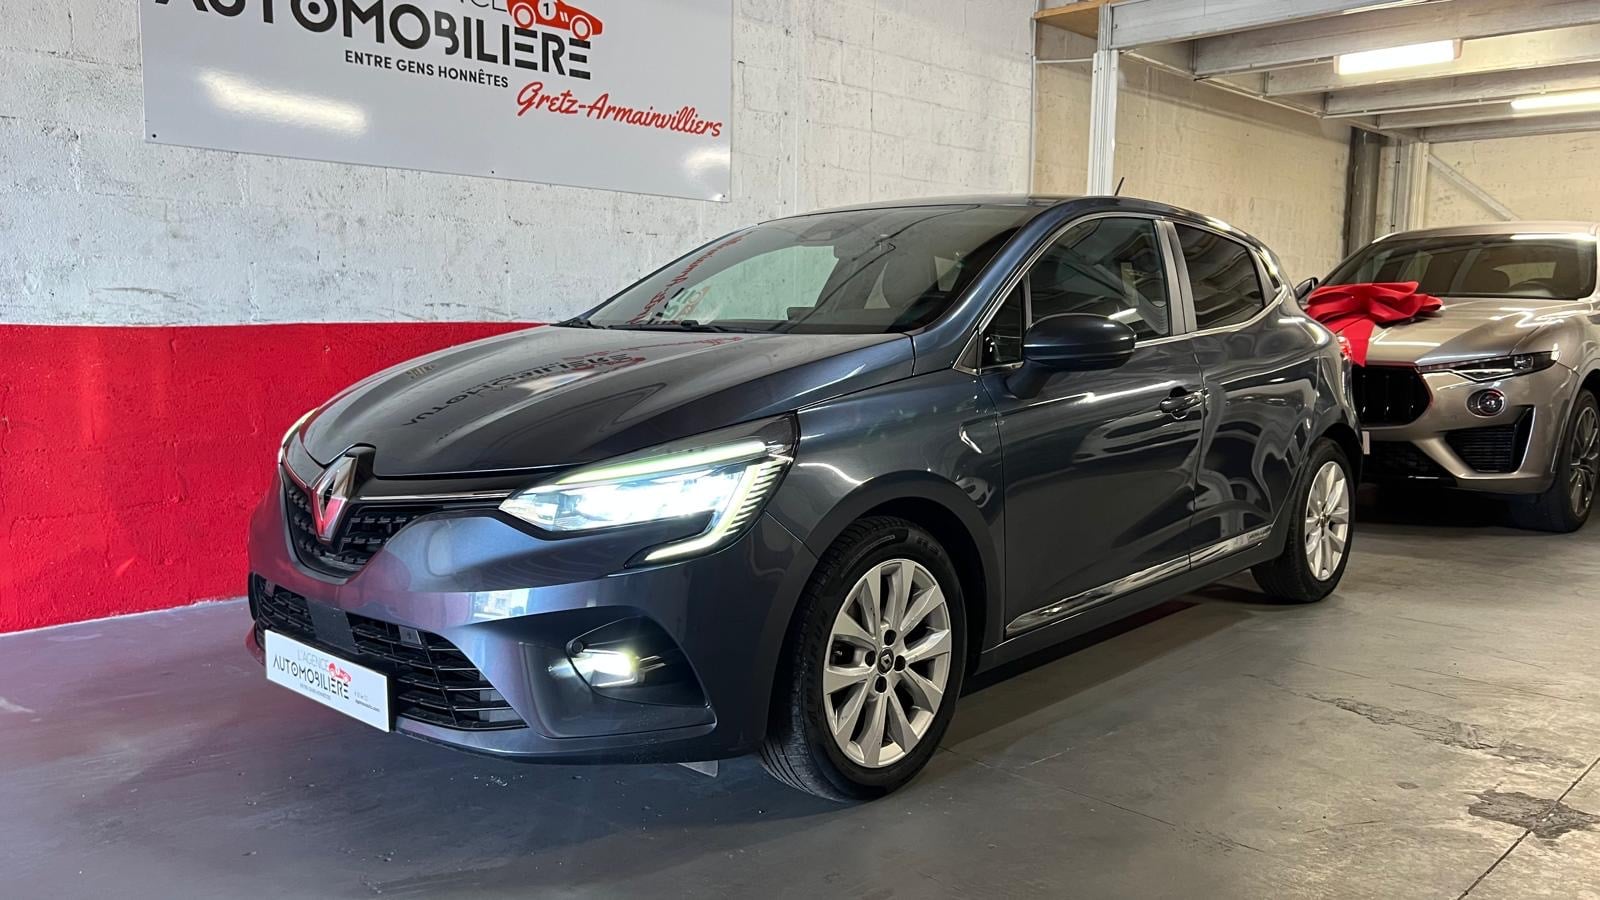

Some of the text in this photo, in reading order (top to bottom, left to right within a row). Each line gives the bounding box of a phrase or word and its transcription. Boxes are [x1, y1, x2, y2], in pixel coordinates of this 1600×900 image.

[155, 0, 591, 80] OMOBILIERE
[345, 50, 509, 88] ENTRE GENS HONNÊTES
[516, 81, 723, 137] Gretz-Armainvilliers
